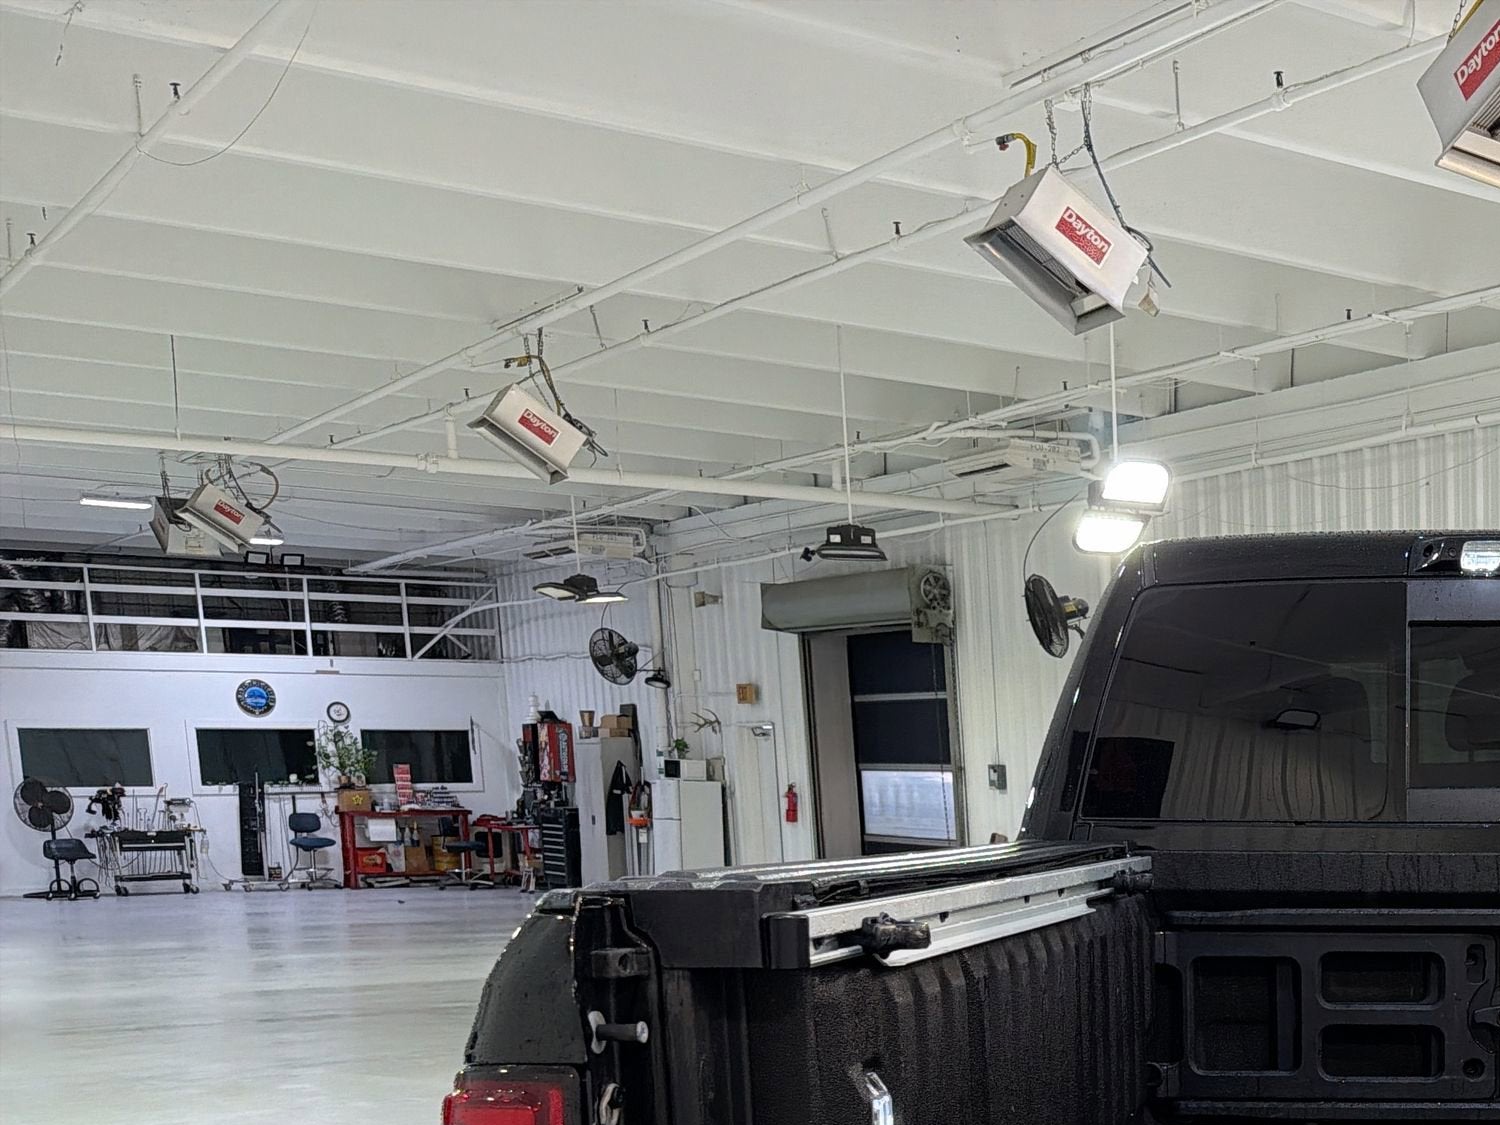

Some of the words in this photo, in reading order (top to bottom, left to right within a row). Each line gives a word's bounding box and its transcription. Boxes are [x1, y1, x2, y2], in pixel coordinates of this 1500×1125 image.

[1064, 208, 1109, 252] Dayton
[524, 409, 559, 438] Dayton
[217, 500, 243, 520] Dayton
